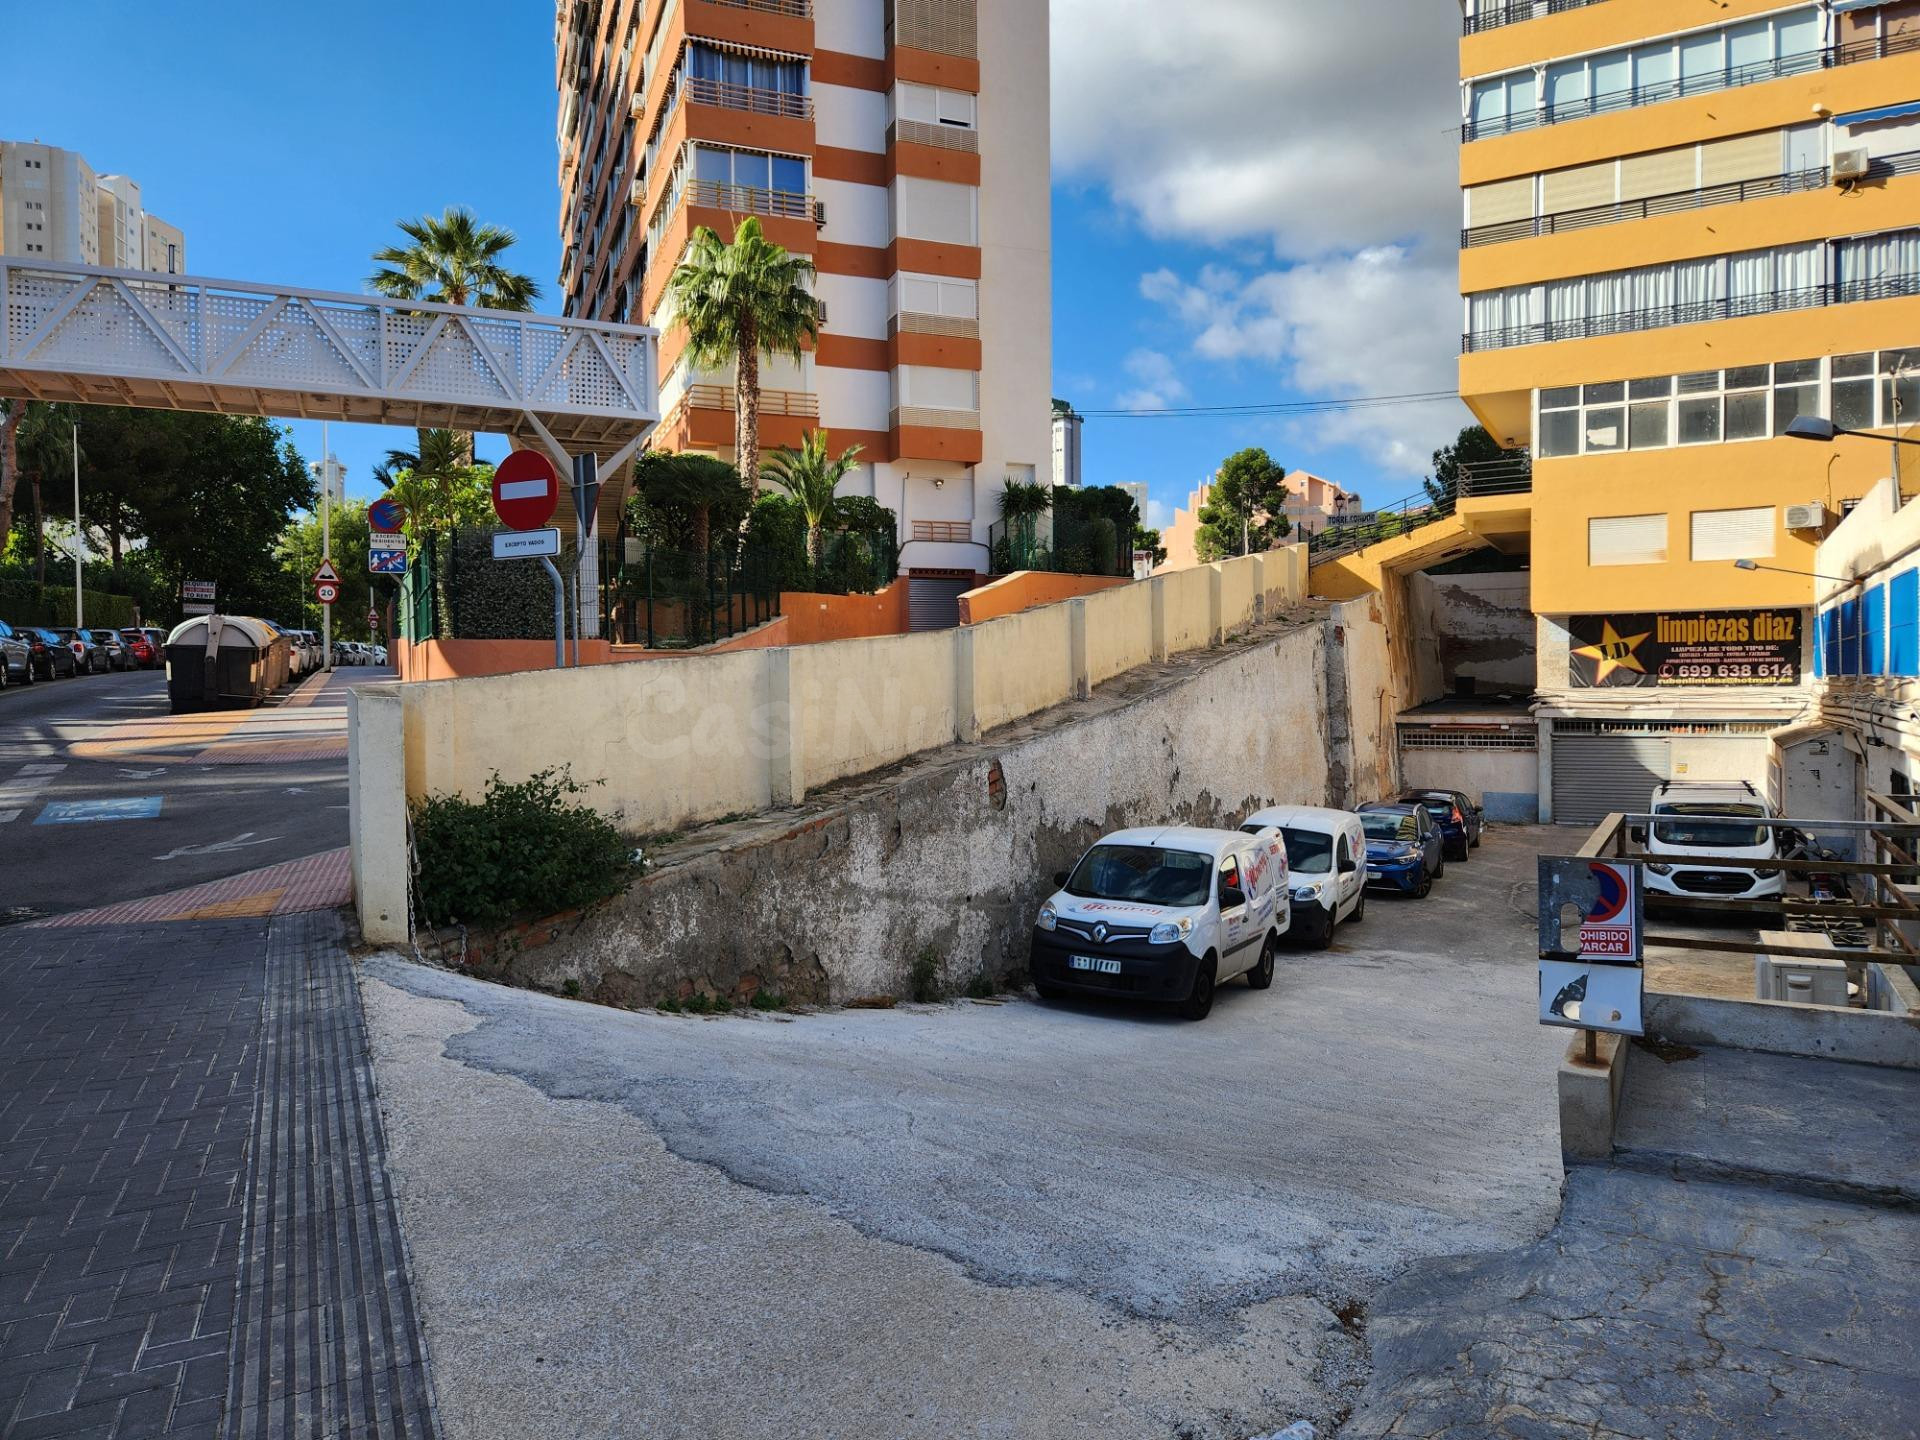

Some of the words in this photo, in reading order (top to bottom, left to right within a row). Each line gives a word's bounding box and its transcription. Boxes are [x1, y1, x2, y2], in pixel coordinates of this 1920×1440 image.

[504, 540, 527, 548] EXCEPTO
[1657, 615, 1750, 645] limpiezas
[1753, 612, 1795, 641] diaz
[1678, 665, 1712, 677] 699
[1717, 664, 1752, 677] 638
[1757, 663, 1794, 677] 614
[1579, 930, 1628, 941] OHIBIDO
[1579, 942, 1624, 952] ARCAR
